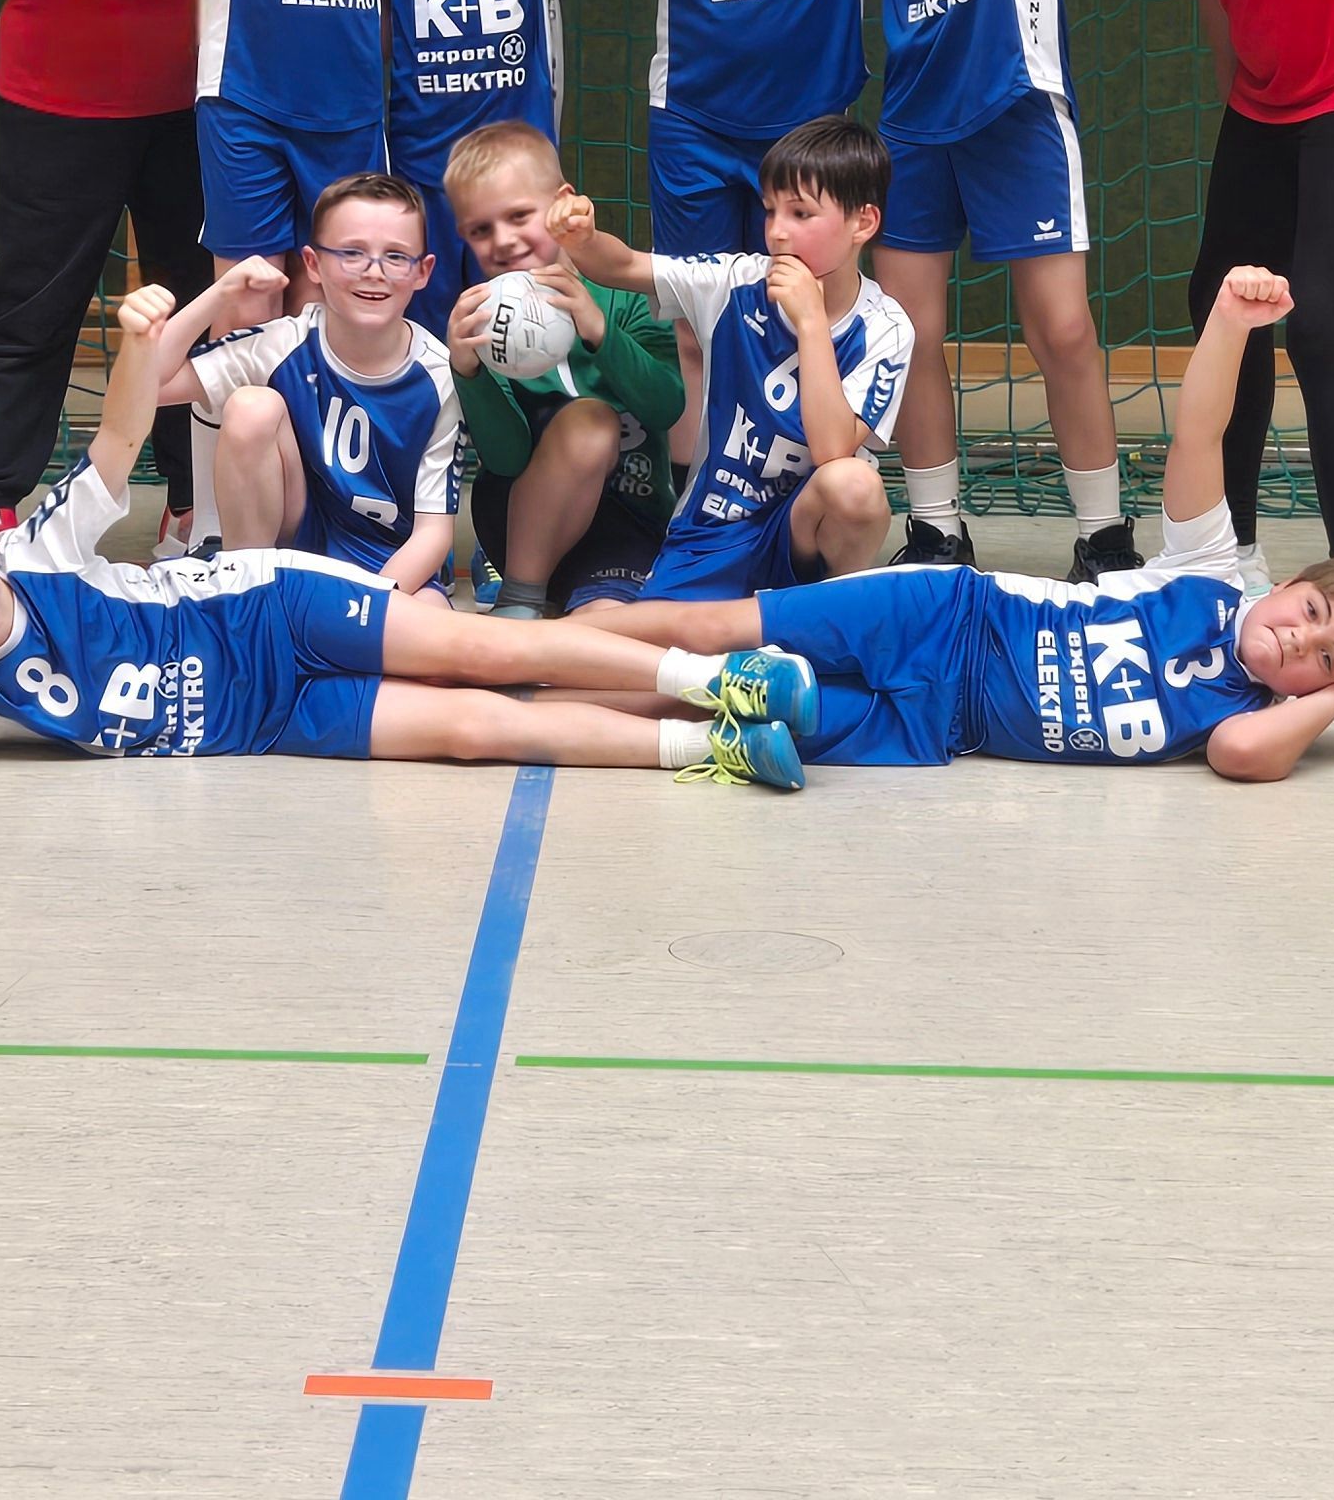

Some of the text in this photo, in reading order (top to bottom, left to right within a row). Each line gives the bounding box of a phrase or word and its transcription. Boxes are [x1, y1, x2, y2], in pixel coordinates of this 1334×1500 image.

[417, 45, 496, 65] expert
[417, 67, 526, 94] ELEKTRO
[764, 352, 799, 412] 6
[323, 396, 370, 474] 10
[16, 657, 79, 718] 8
[1037, 629, 1065, 753] ELEKTRO
[1068, 631, 1093, 725] expert
[1084, 619, 1166, 758] K+B
[1164, 647, 1225, 688] 3
